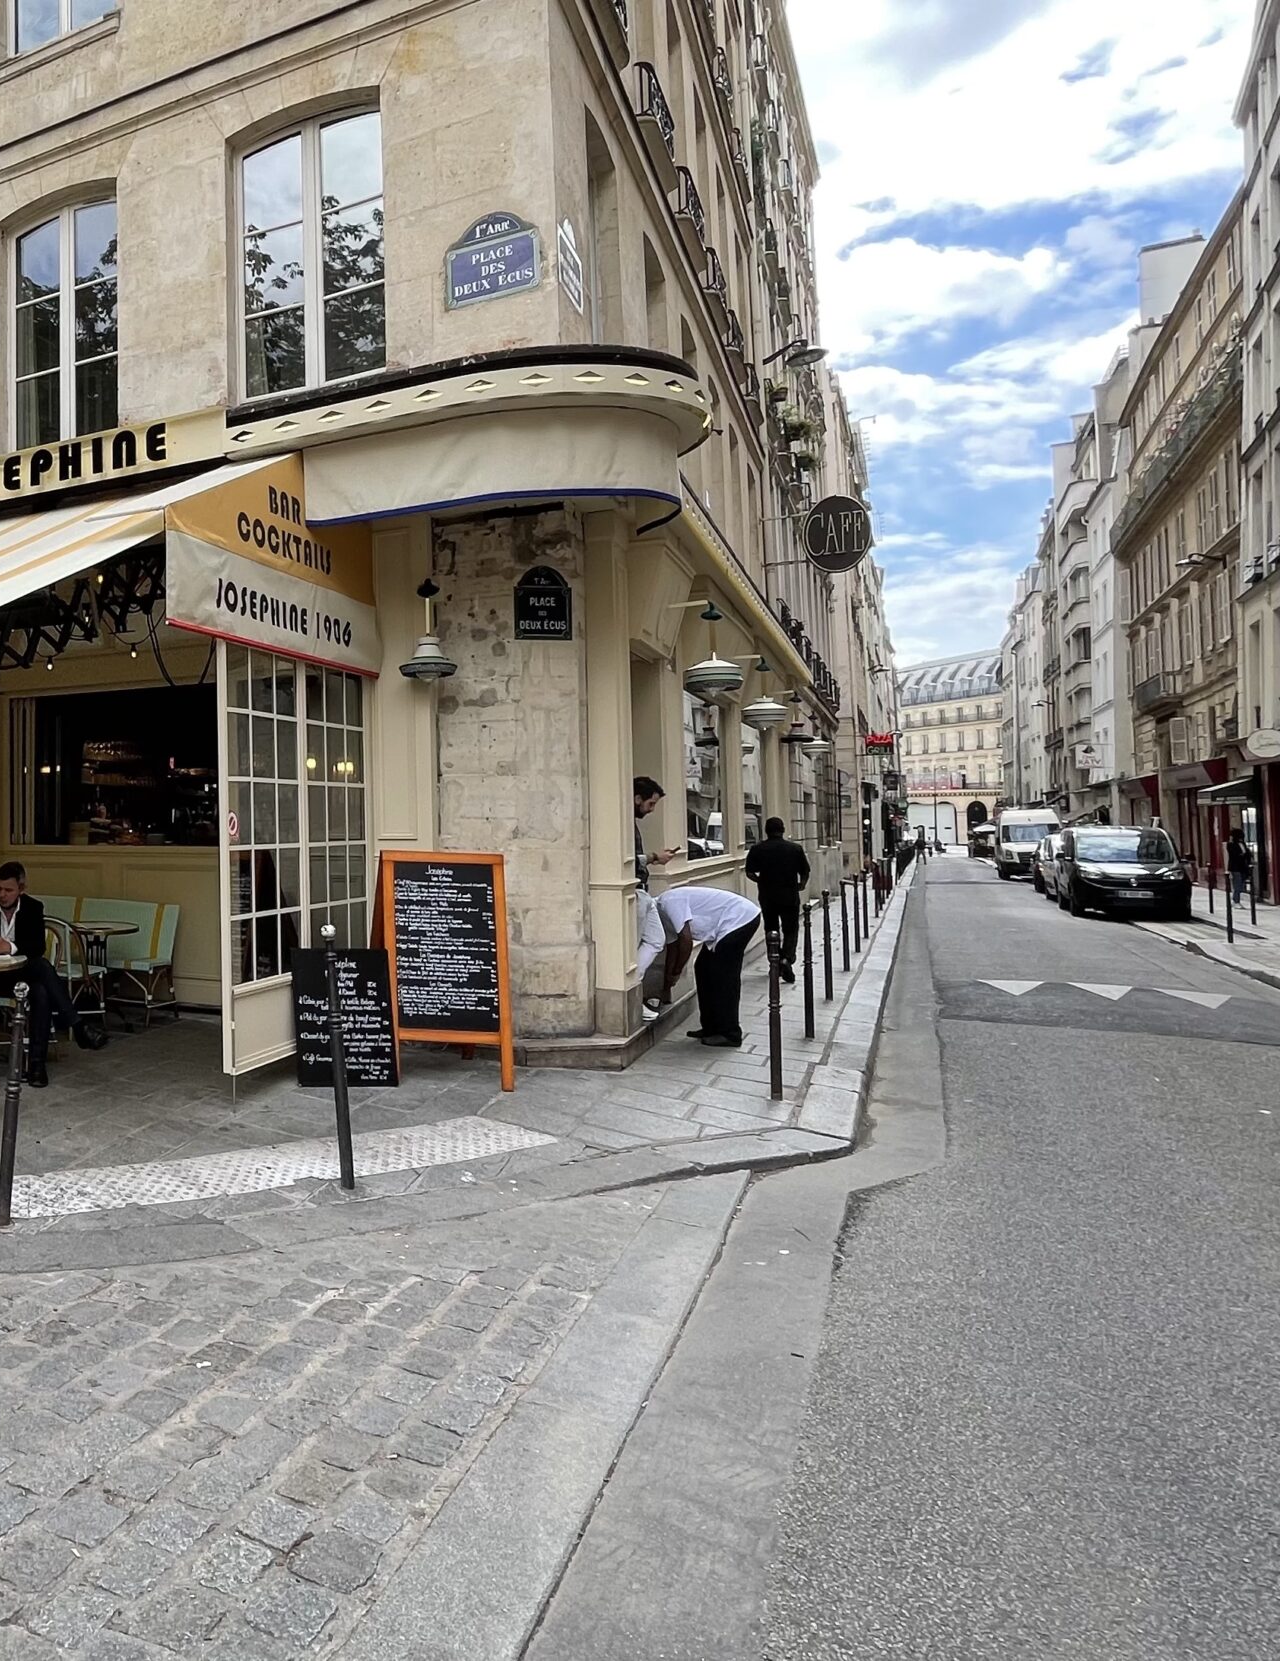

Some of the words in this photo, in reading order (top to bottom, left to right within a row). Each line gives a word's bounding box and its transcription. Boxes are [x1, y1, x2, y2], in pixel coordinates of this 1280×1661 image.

[471, 245, 513, 265] PLACE
[481, 261, 506, 277] DES
[454, 278, 491, 297] DEUX
[498, 267, 534, 286] ÉCUS
[268, 485, 301, 525] BAR
[237, 511, 332, 575] COCKTAILS
[806, 510, 864, 556] CAFE
[216, 578, 308, 636] JOSEPHINE
[316, 611, 352, 648] 1906
[529, 597, 556, 607] PLACE
[520, 620, 541, 630] DEUX
[866, 734, 893, 744] PIZZA
